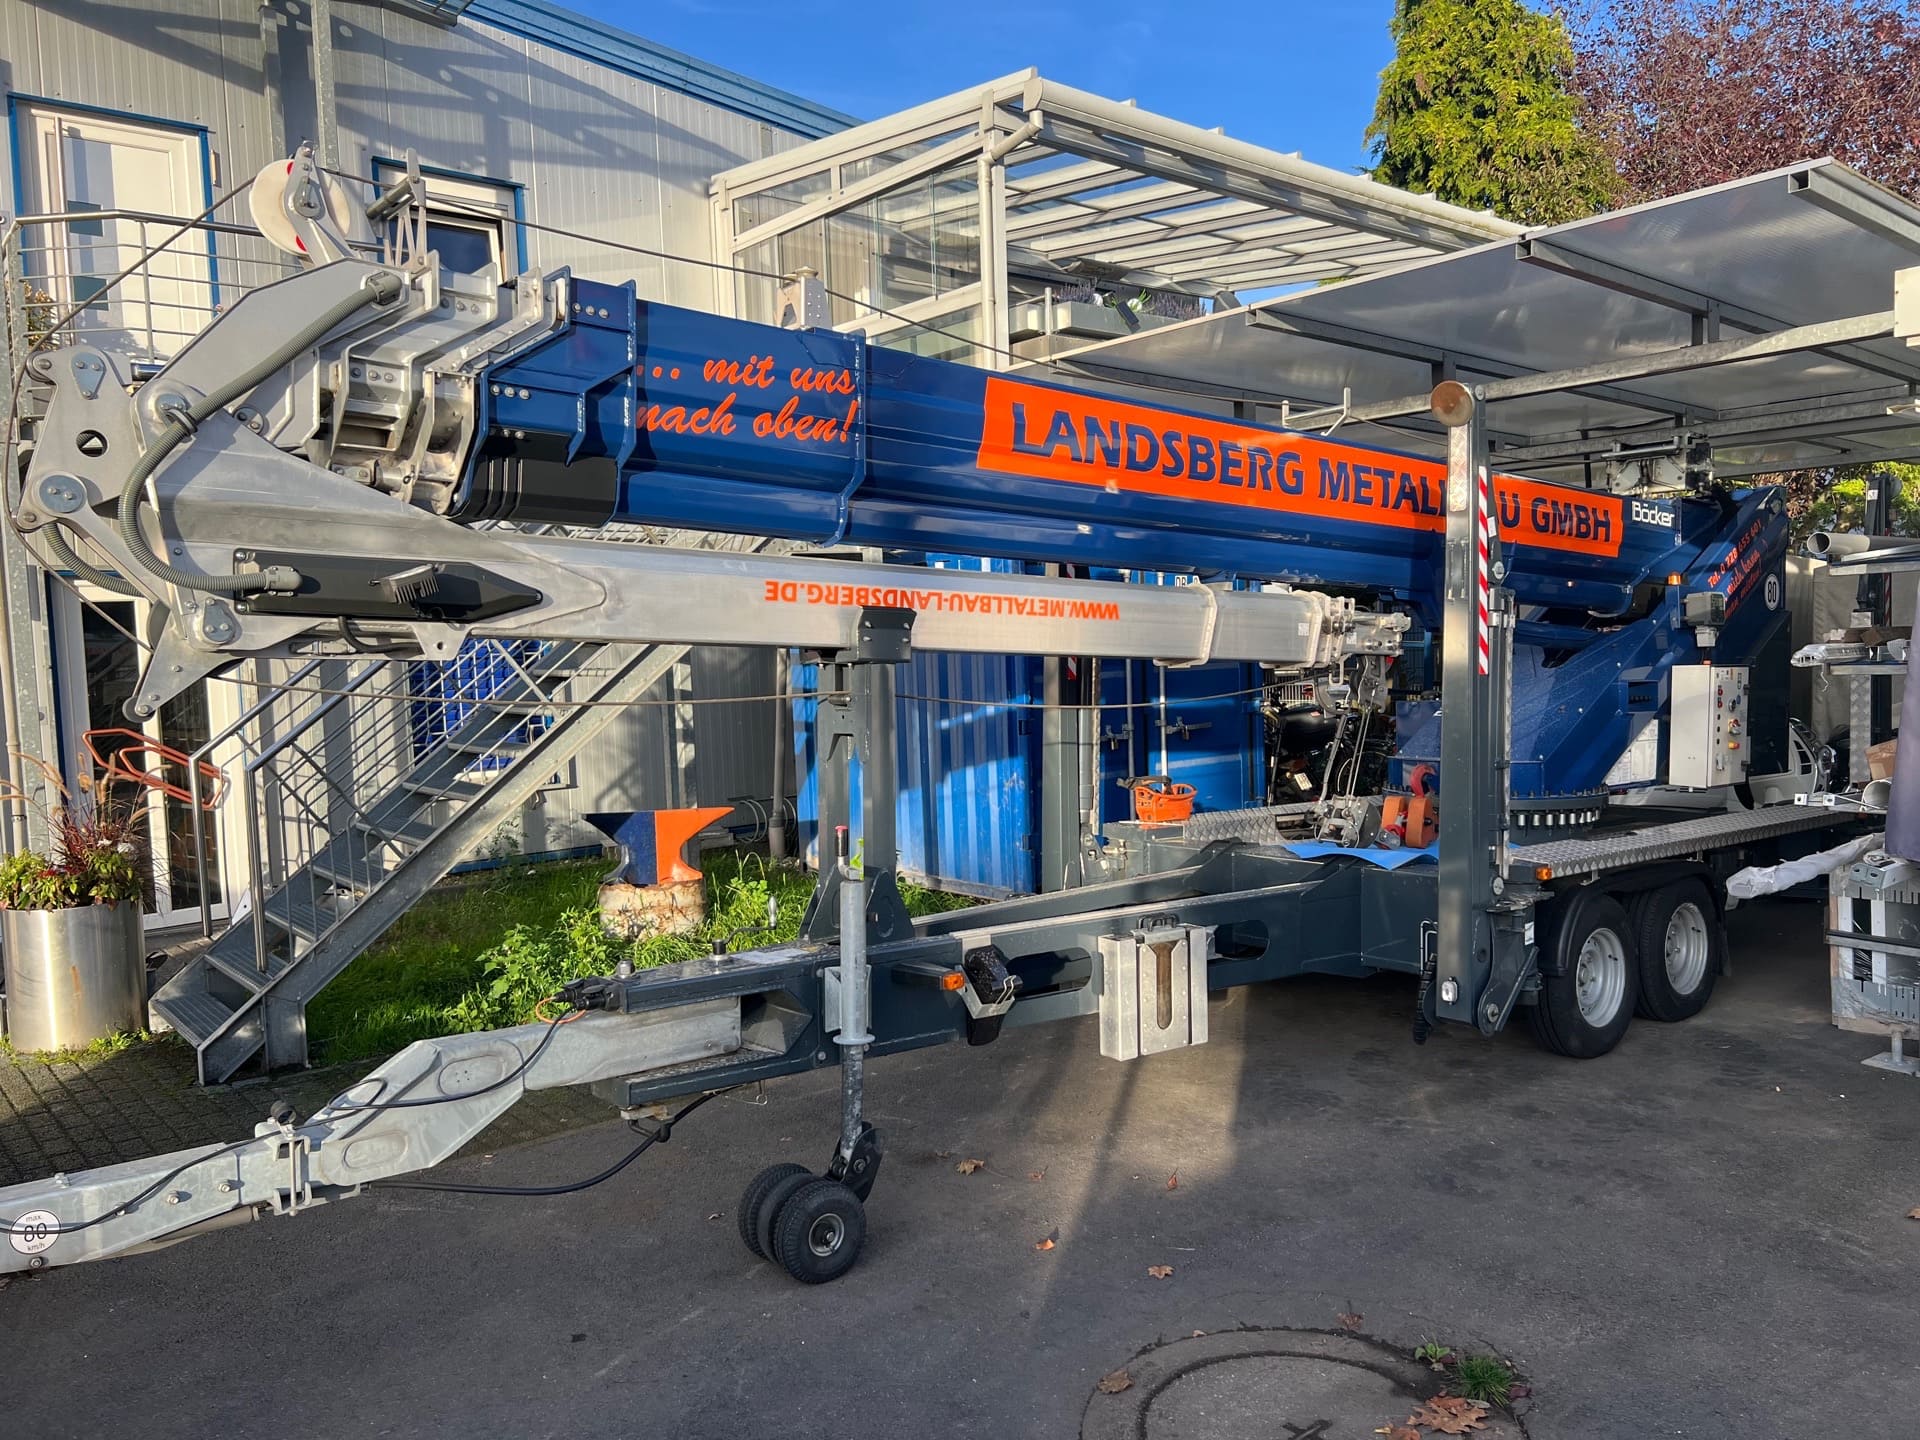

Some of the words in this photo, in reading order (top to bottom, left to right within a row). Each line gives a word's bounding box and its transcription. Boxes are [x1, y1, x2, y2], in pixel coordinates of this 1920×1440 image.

[702, 355, 776, 389] mit
[789, 367, 856, 395] uns
[636, 392, 738, 436] nach
[752, 395, 859, 443] oben!
[1012, 401, 1305, 495] LANDSBERG
[1531, 495, 1611, 543] GMBH
[1631, 500, 1675, 528] Böcker
[1725, 547, 1738, 568] 228
[765, 580, 1121, 620] WWW.METALLBAU-LANDSBERG.DE
[1767, 581, 1777, 603] 80
[24, 1222, 47, 1243] 80
